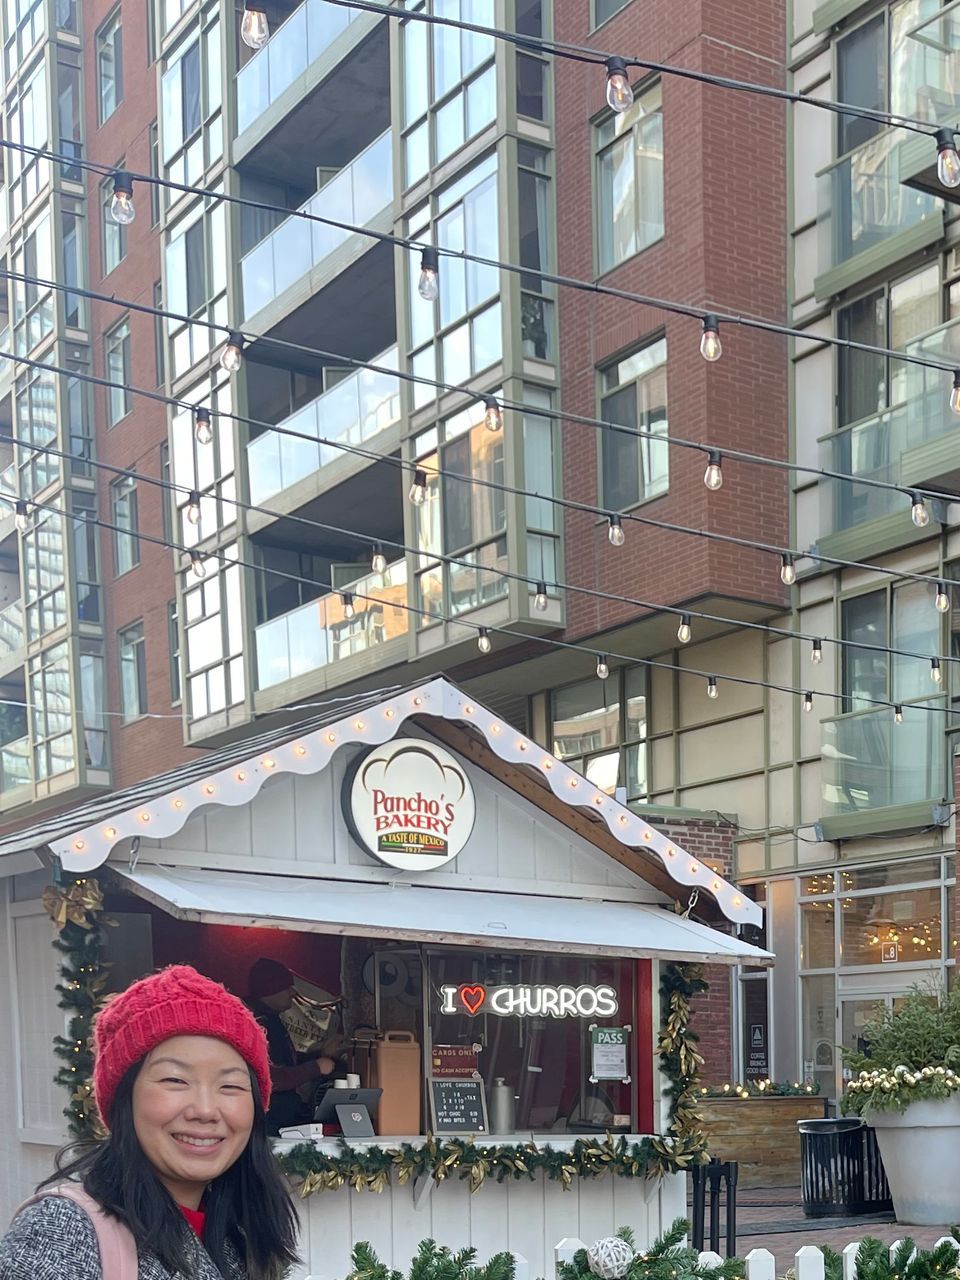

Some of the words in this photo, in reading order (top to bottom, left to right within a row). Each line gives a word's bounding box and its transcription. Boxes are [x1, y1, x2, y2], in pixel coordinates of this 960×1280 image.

[372, 789, 454, 822] Pancho's
[374, 814, 452, 836] BAKERY
[388, 832, 408, 843] TASTE
[408, 832, 418, 843] OF
[418, 834, 445, 846] MEXICO
[889, 946, 895, 959] 8
[445, 987, 457, 1012] I
[491, 987, 616, 1015] CHURROS
[598, 1032, 623, 1044] PASS
